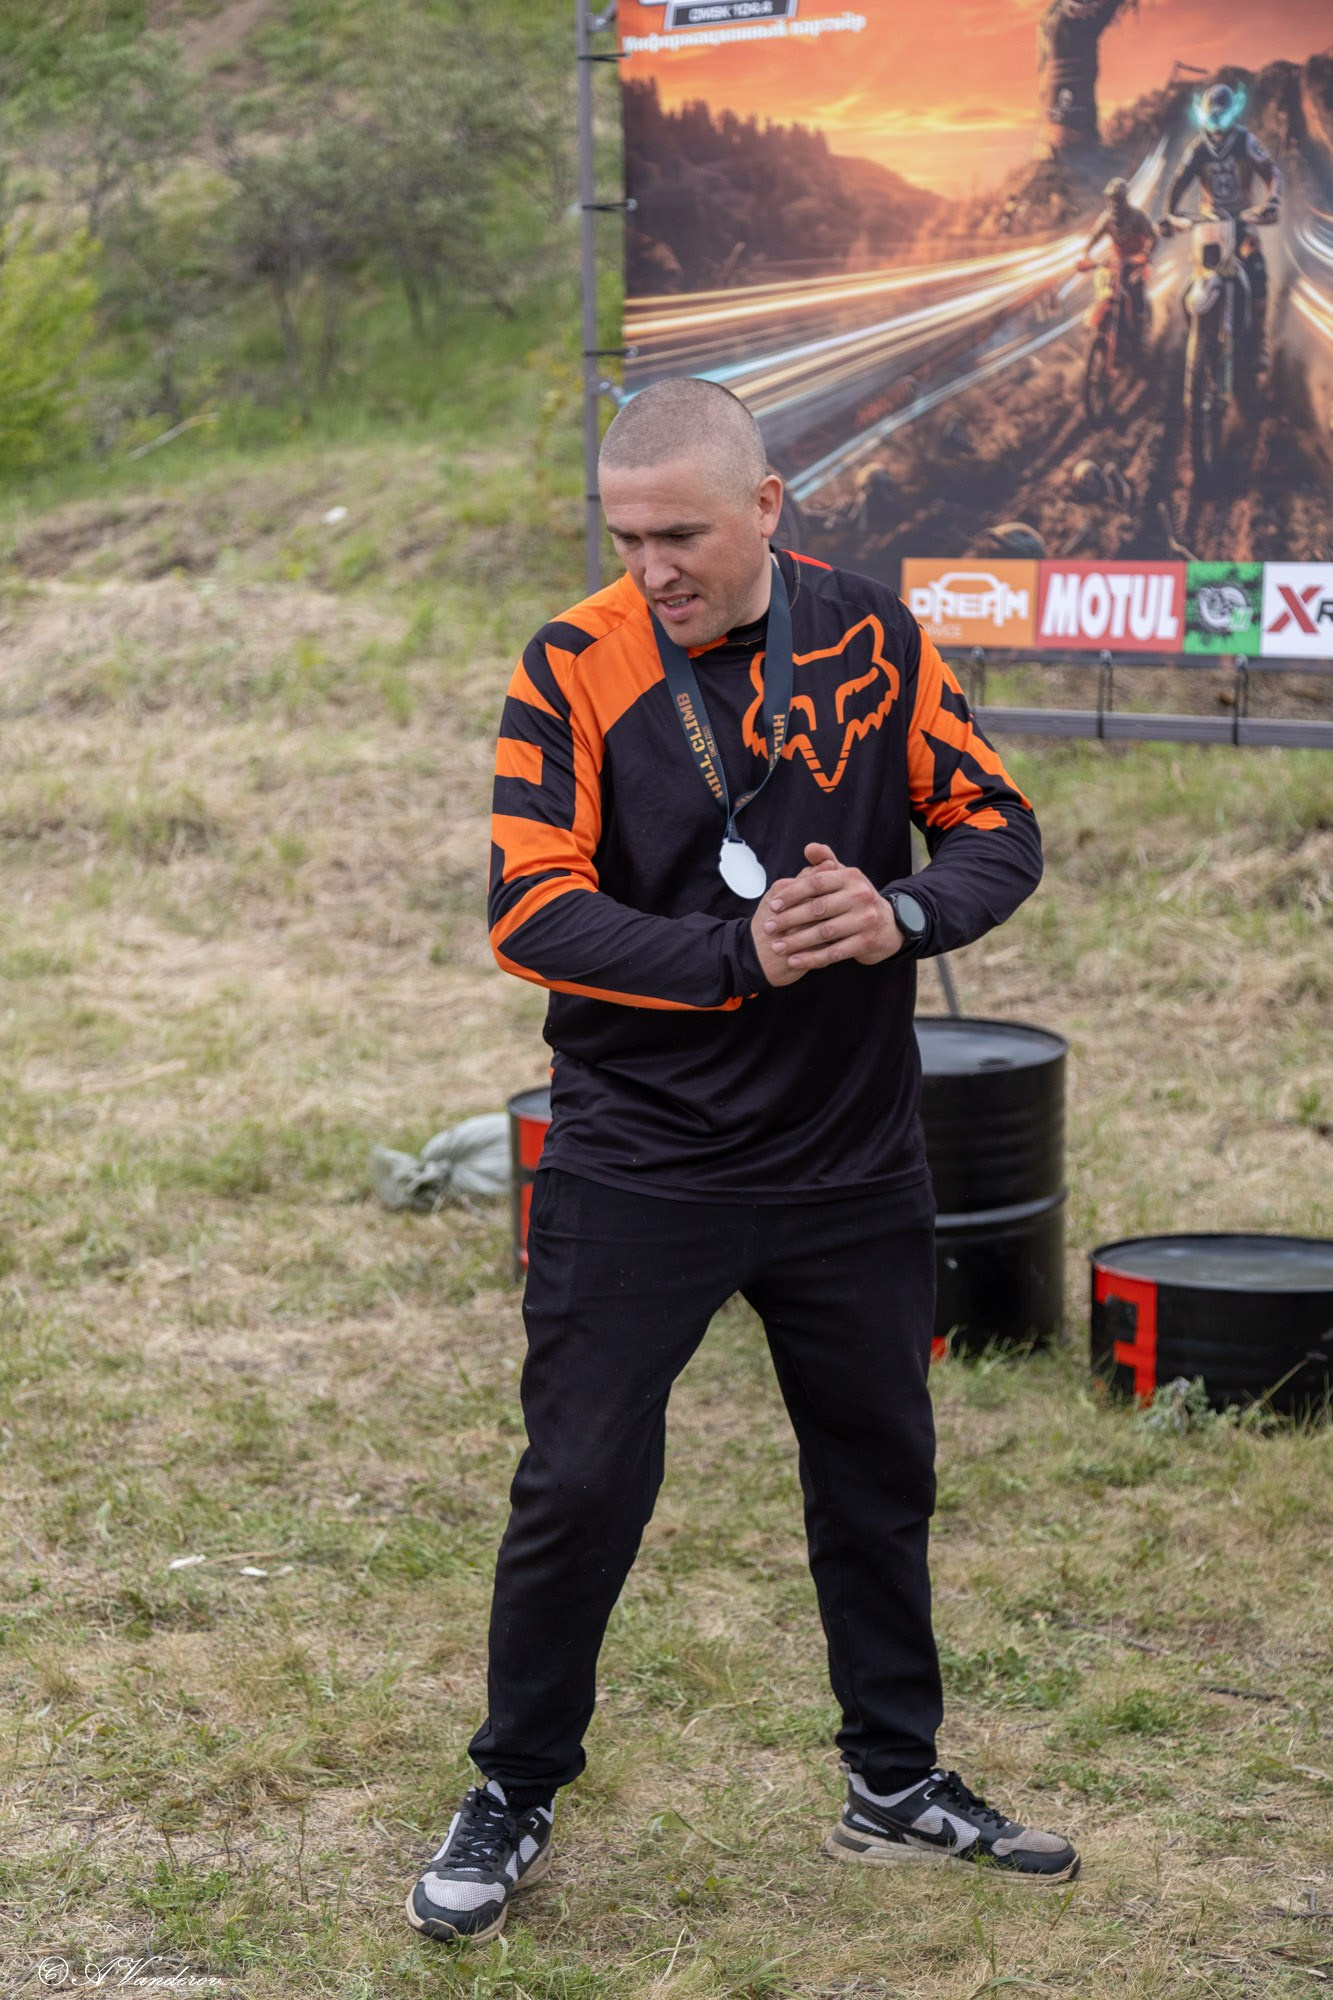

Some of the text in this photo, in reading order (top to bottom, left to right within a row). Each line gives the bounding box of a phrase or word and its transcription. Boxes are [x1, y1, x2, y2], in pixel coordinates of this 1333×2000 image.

[910, 581, 1029, 626] DREAM
[1040, 573, 1179, 640] MOTUL
[677, 692, 723, 798] HILL CLIMB
